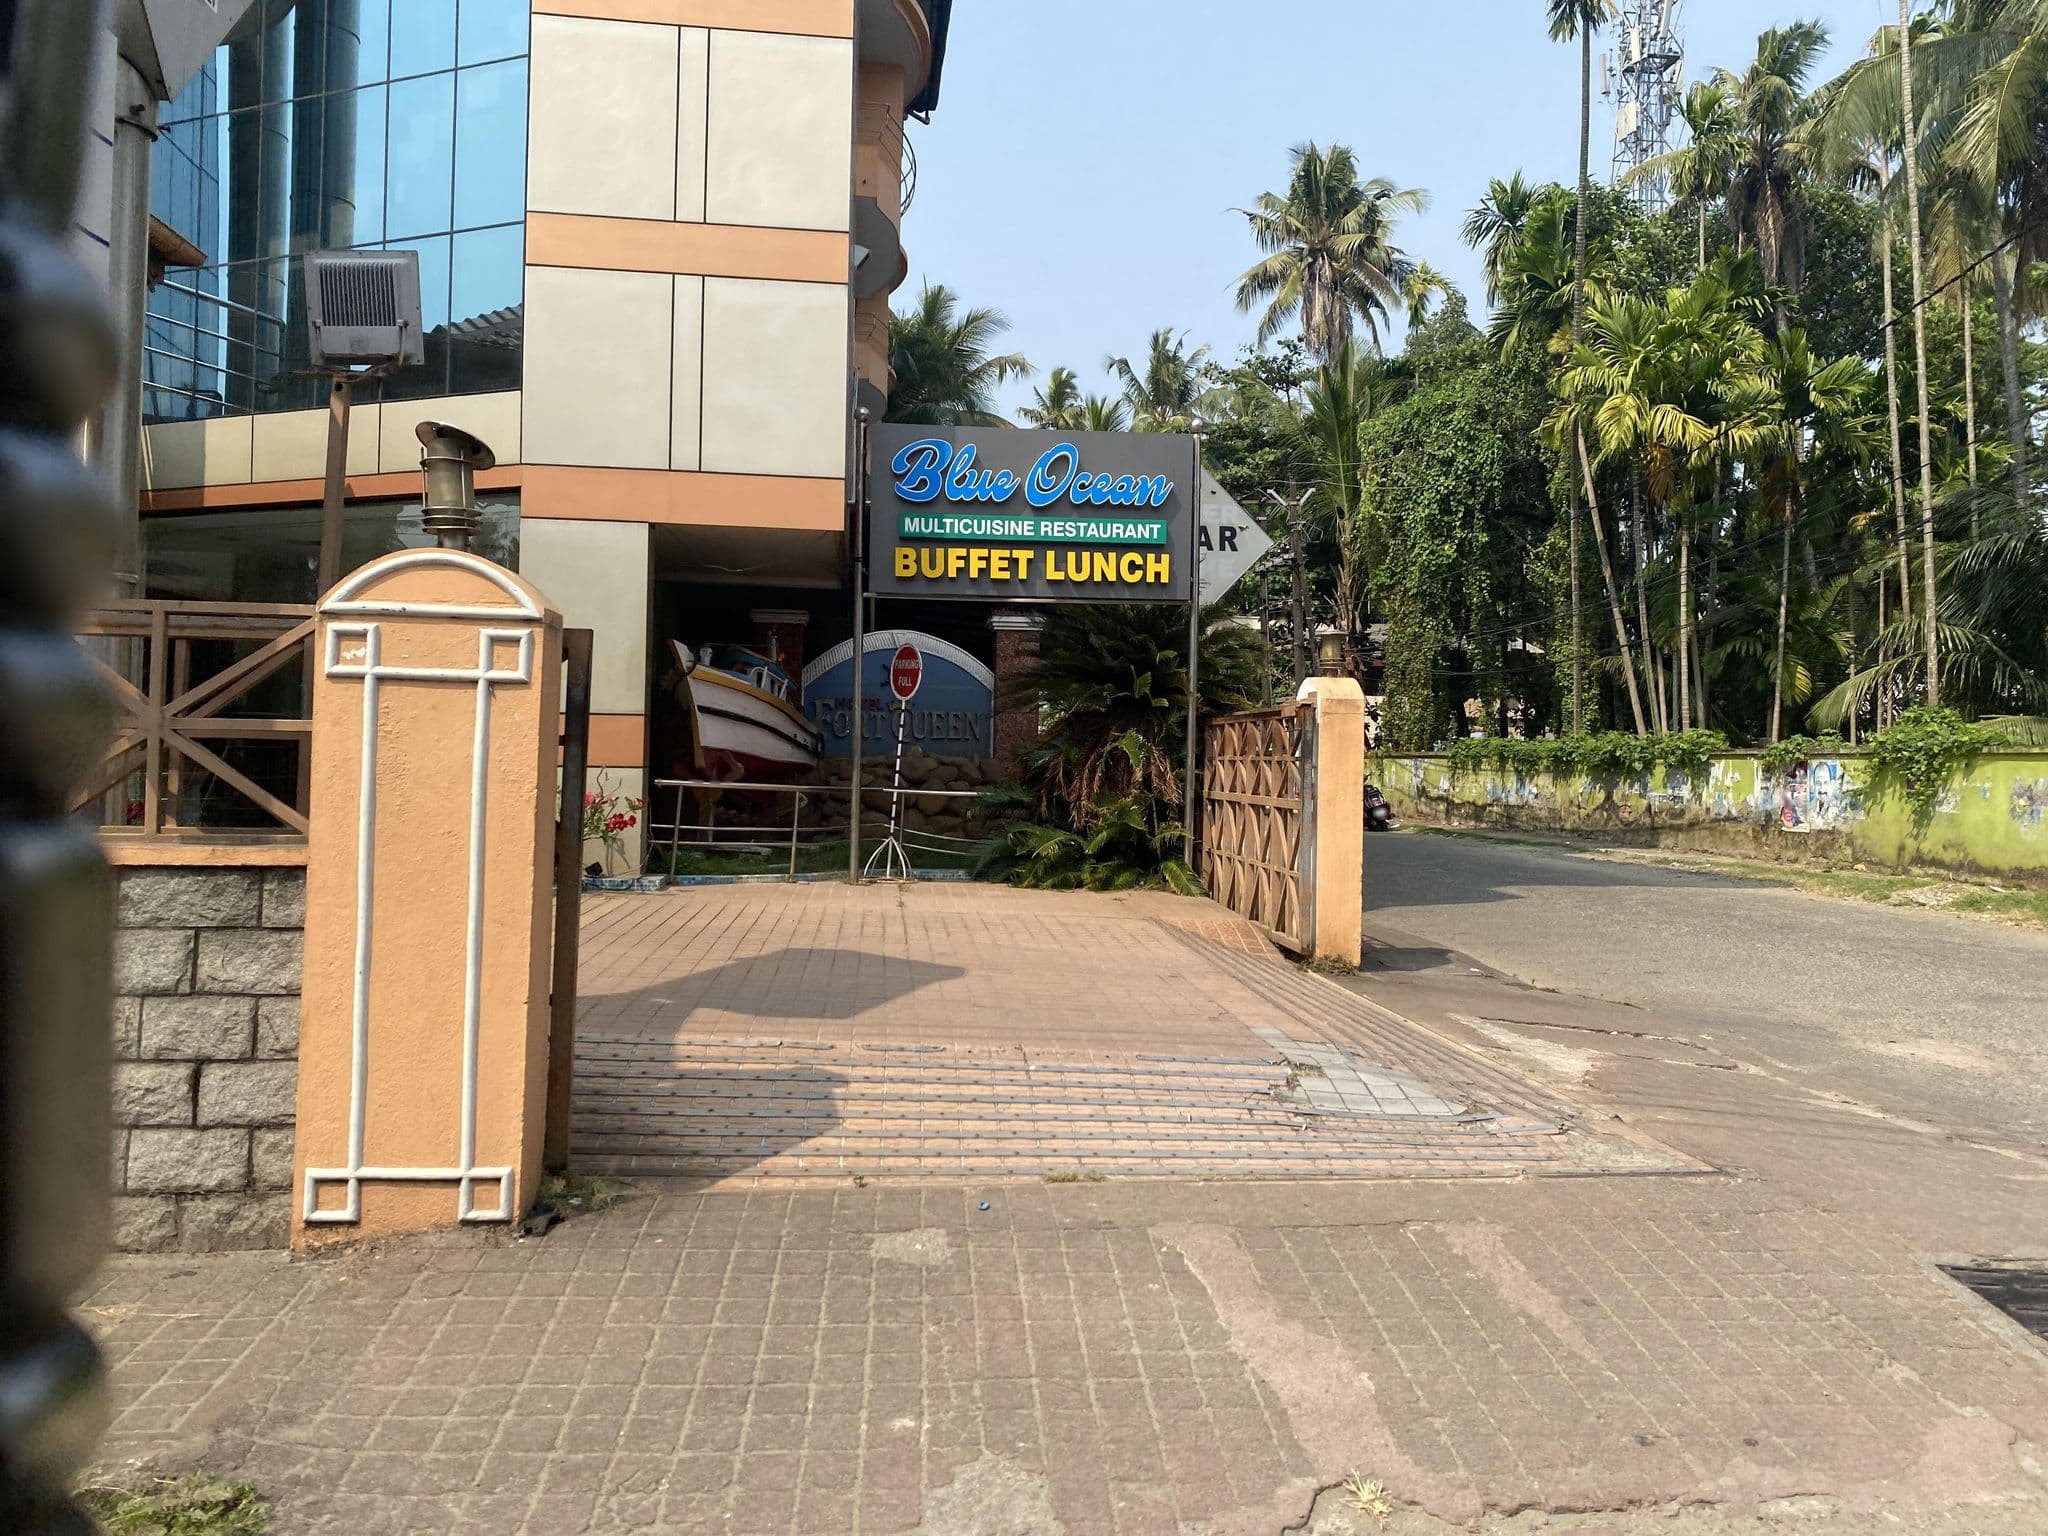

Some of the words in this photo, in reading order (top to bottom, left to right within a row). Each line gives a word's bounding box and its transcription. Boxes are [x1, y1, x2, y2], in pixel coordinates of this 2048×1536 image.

[891, 438, 1022, 502] Blue
[1025, 442, 1174, 507] Ocean
[903, 517, 1035, 536] MULTICUISINE
[1040, 521, 1162, 539] RESTAURANT
[894, 546, 1034, 580] BUFFET
[1046, 550, 1170, 584] LUNCH
[895, 659, 920, 670] PARKING
[898, 676, 912, 687] FULL
[889, 711, 983, 743] QUEEN
